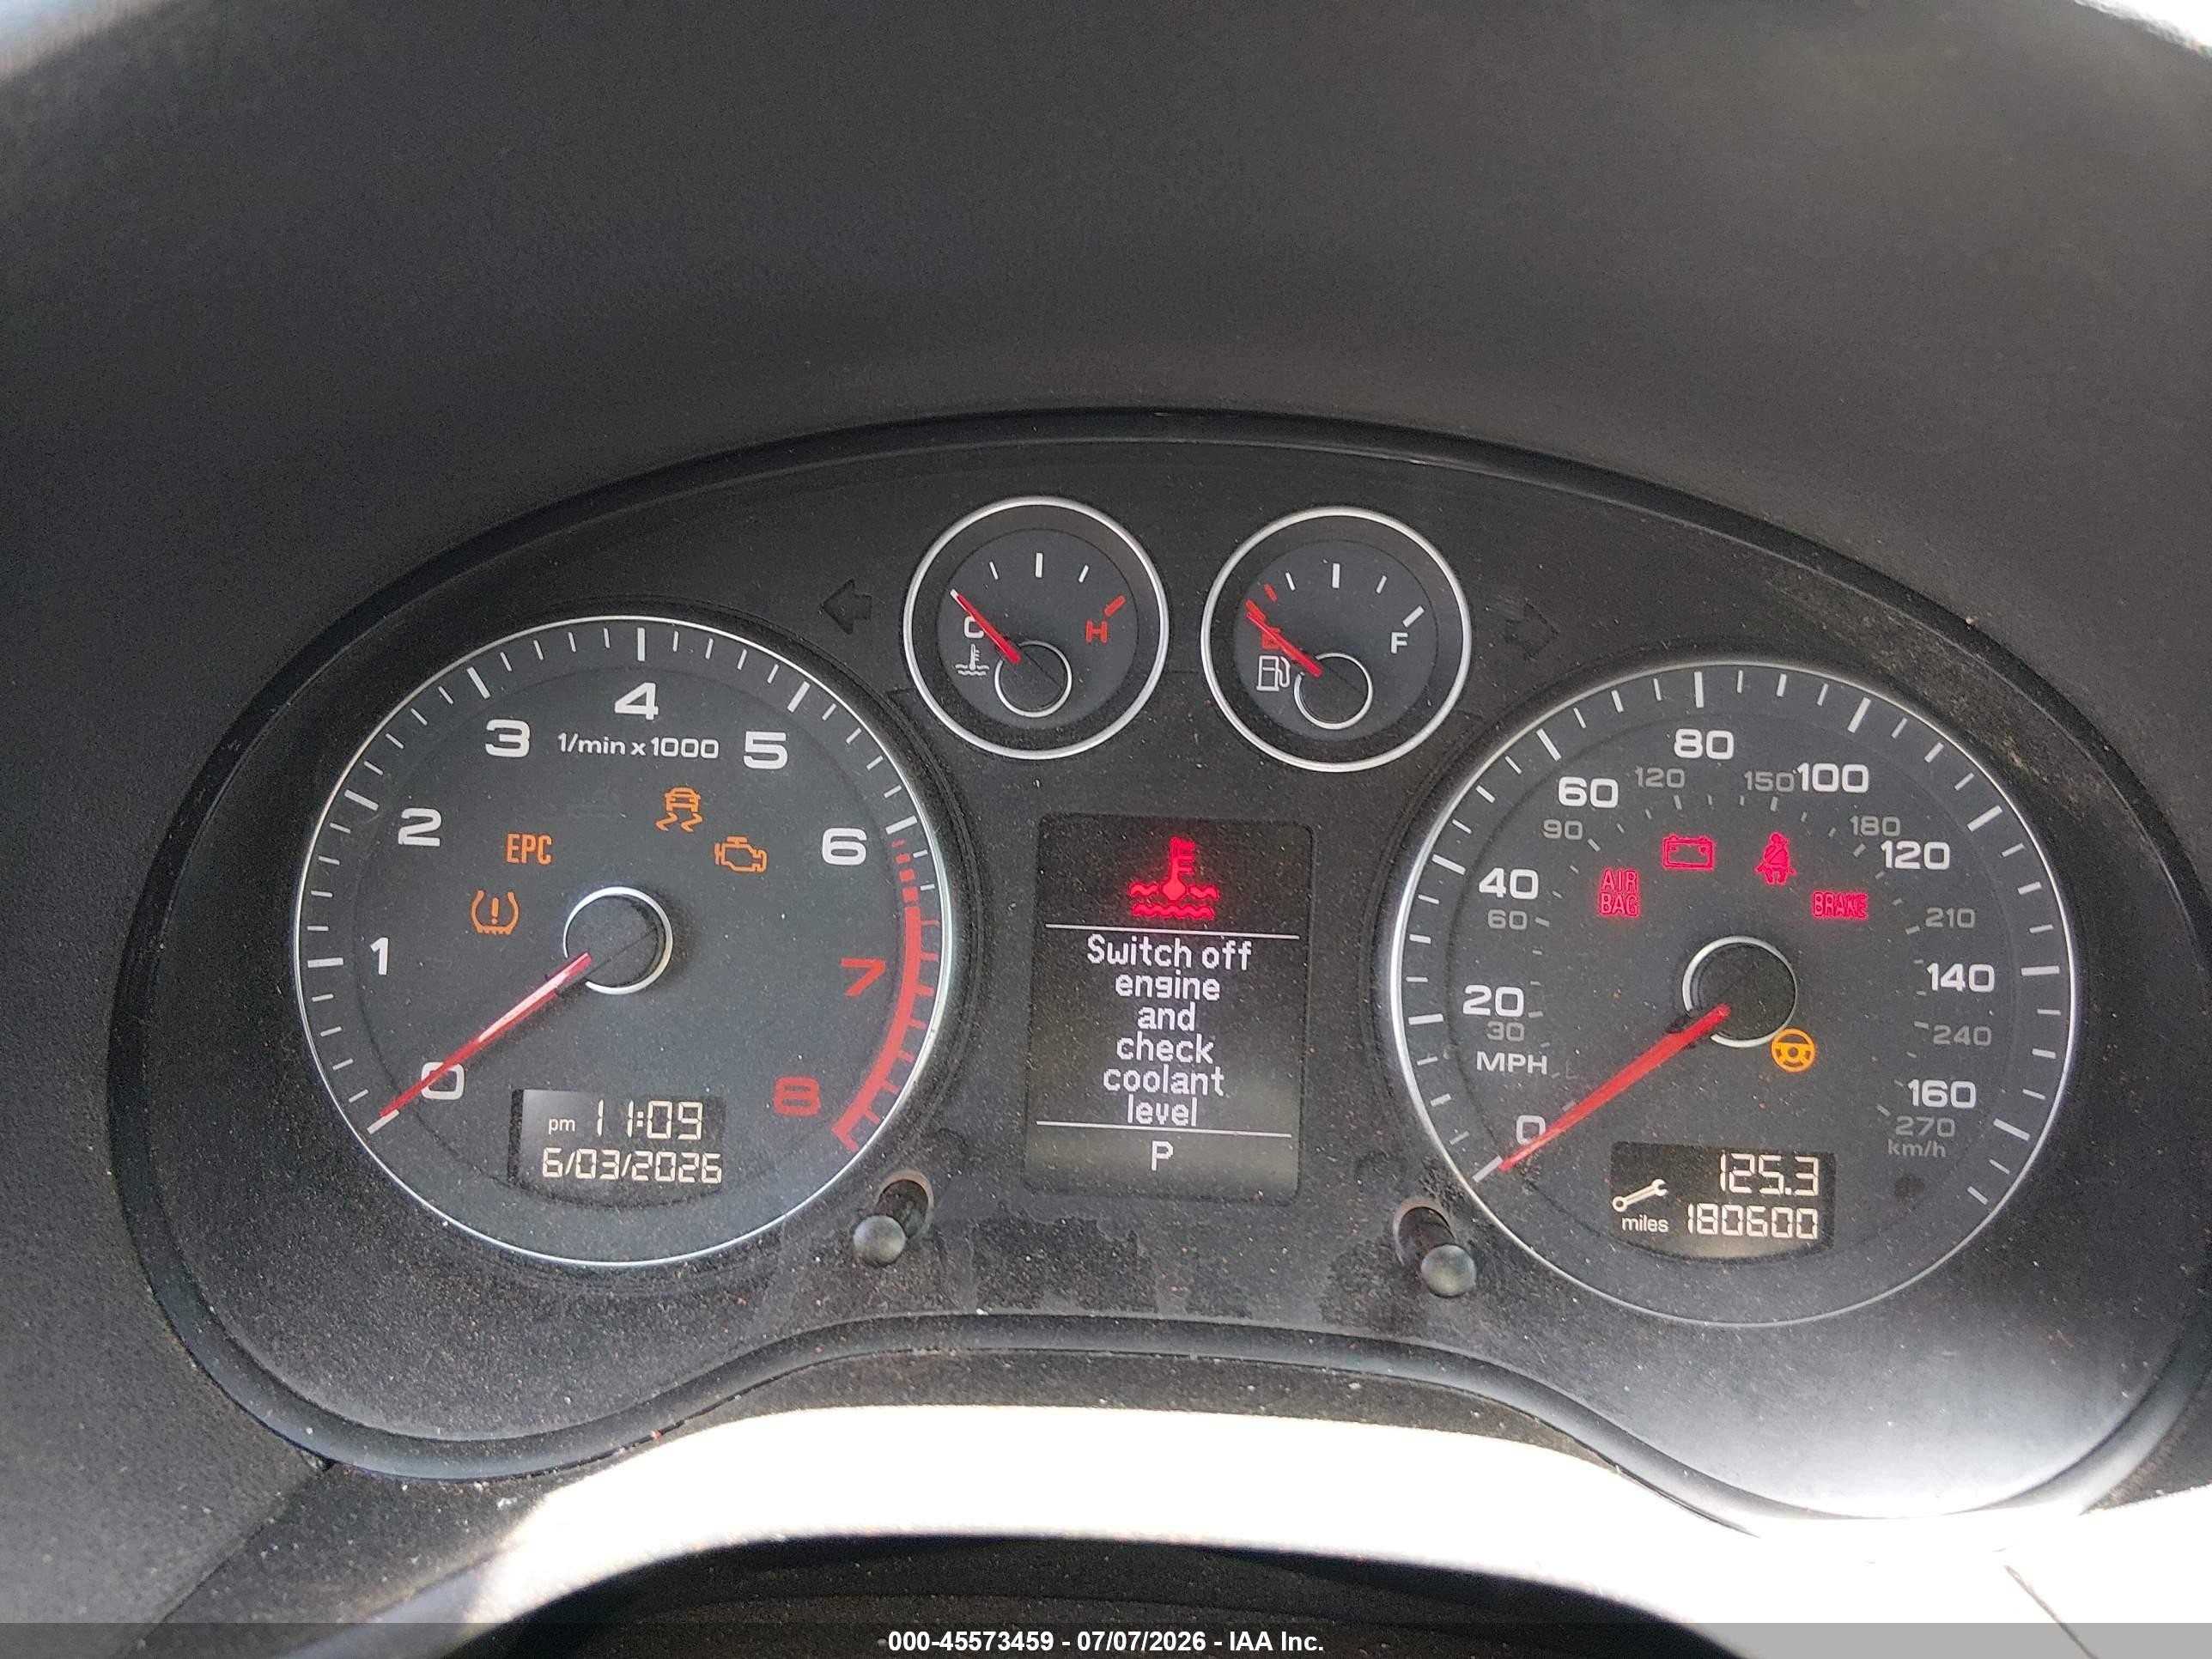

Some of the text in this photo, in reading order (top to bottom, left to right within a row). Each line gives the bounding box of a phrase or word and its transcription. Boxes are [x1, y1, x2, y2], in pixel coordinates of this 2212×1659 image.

[1085, 620, 1108, 642] H
[1390, 632, 1408, 653] F
[615, 683, 659, 720] 4
[484, 720, 531, 758] 3
[558, 732, 626, 755] 1/min
[743, 732, 789, 769] 5
[1674, 728, 1734, 760] 80
[1558, 776, 1619, 809] 60
[1635, 767, 1686, 788] 120
[1744, 771, 1794, 793] 150
[1796, 763, 1870, 793] 100
[398, 808, 442, 848] 2
[1543, 819, 1583, 841] 90
[1850, 816, 1901, 837] 180
[507, 833, 553, 865] EPC
[821, 827, 867, 866] 6
[1880, 841, 1951, 871] 120
[1479, 867, 1540, 900] 40
[1600, 868, 1639, 894] AIR
[1599, 891, 1640, 917] BAG
[1813, 891, 1869, 920] BRAKE
[1924, 908, 1976, 928] 210
[1487, 909, 1528, 931] 60
[370, 937, 391, 975] 1
[1087, 933, 1253, 970] Switch off
[841, 957, 886, 996] 7
[1115, 969, 1221, 1001] engine
[1926, 963, 1996, 993] 140
[1137, 1002, 1197, 1031] and
[1462, 984, 1525, 1018] 20
[1486, 1021, 1525, 1042] 30
[1932, 1025, 1992, 1046] 240
[1115, 1033, 1215, 1065] check
[1476, 1050, 1548, 1075] MPH
[421, 1062, 465, 1101] 0
[774, 1076, 821, 1115] 8
[1103, 1065, 1225, 1097] coolant
[1907, 1079, 1976, 1109] 160
[548, 1098, 703, 1140] pm 11:09
[1127, 1094, 1199, 1127] level
[1516, 1115, 1547, 1145] 0
[1895, 1116, 1955, 1138] 270
[1151, 1140, 1175, 1171] P
[1888, 1139, 1946, 1158] km/h
[542, 1147, 722, 1184] 6/03/2026
[1719, 1152, 1820, 1196] 125.3
[1621, 1202, 1819, 1240] miles 180600
